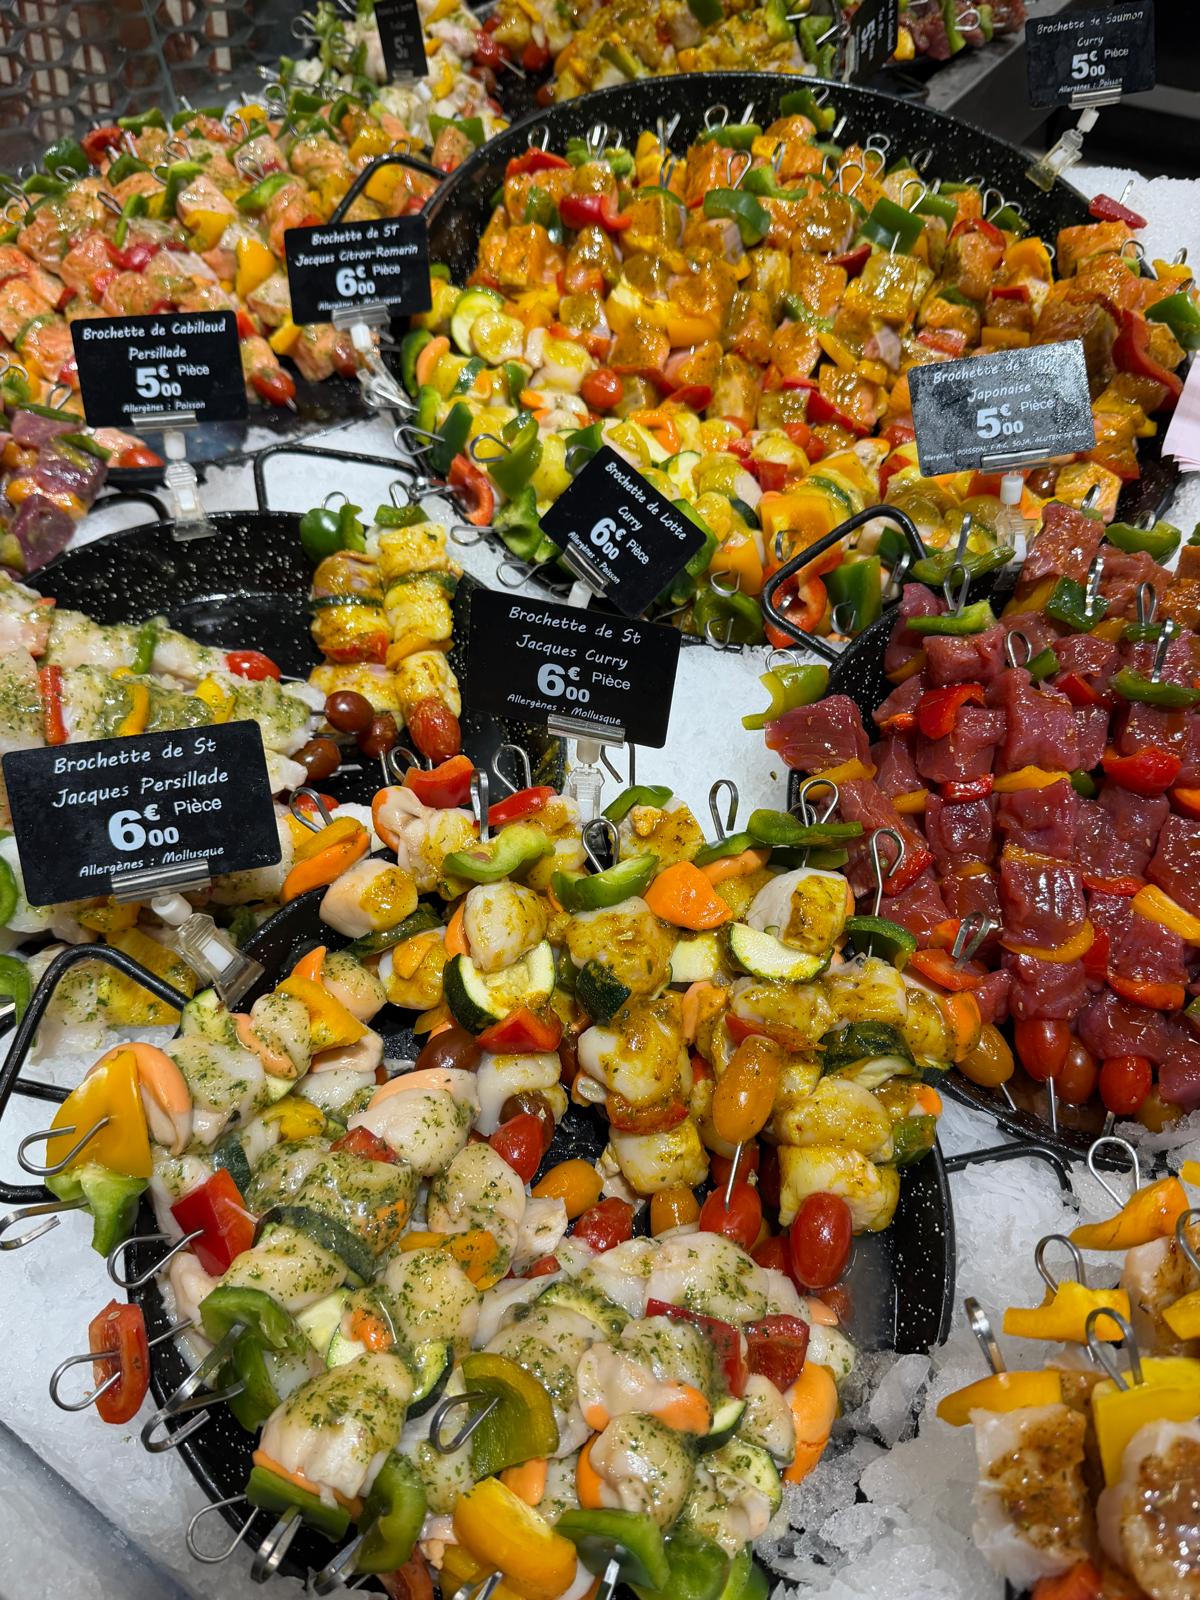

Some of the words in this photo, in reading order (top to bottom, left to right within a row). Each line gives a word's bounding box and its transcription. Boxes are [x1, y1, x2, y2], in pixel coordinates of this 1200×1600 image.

[1037, 20, 1085, 35] Brochette
[1090, 17, 1101, 26] de
[1105, 10, 1144, 24] Saumon
[1077, 36, 1104, 47] Curry
[1104, 48, 1129, 59] Pièce
[311, 230, 362, 246] Brochette
[366, 226, 379, 239] de
[383, 224, 400, 238] ST
[295, 252, 335, 268] Jacques
[339, 243, 419, 262] Citron-Romarin
[372, 263, 401, 277] Pièce
[363, 296, 402, 307] Mollques
[83, 325, 145, 341] Brochette
[150, 323, 166, 337] de
[171, 317, 226, 335] Cabillaud
[128, 344, 187, 361] Persillade
[177, 363, 210, 377] Pièce
[933, 365, 1000, 384] Brochette
[1005, 359, 1021, 372] de
[967, 382, 1032, 403] Japonaise
[122, 402, 164, 414] Allergènes
[175, 400, 206, 411] Poisson
[1020, 399, 1056, 413] Pièce
[604, 461, 646, 504] Brochette
[646, 502, 659, 515] de
[659, 512, 687, 541] Lotte
[617, 506, 643, 532] Curry
[568, 531, 595, 560] Allergènes
[599, 562, 621, 585] Poisson
[626, 538, 650, 565] Pièce
[508, 606, 587, 633] Brochette
[594, 623, 613, 639] de
[621, 628, 642, 645] St
[516, 634, 577, 658] Jacques
[585, 649, 629, 671] Curry
[592, 671, 631, 690] Pièce
[507, 693, 558, 712] Allergènes
[570, 707, 622, 726] Mollusque
[54, 748, 151, 774] Brochette
[162, 740, 183, 760] de
[194, 737, 217, 756] St
[52, 784, 129, 808] Jacques
[141, 767, 229, 795] Persillade
[174, 797, 222, 816] Pièce
[79, 859, 144, 878] Allergènes
[162, 846, 225, 865] Mollusque
